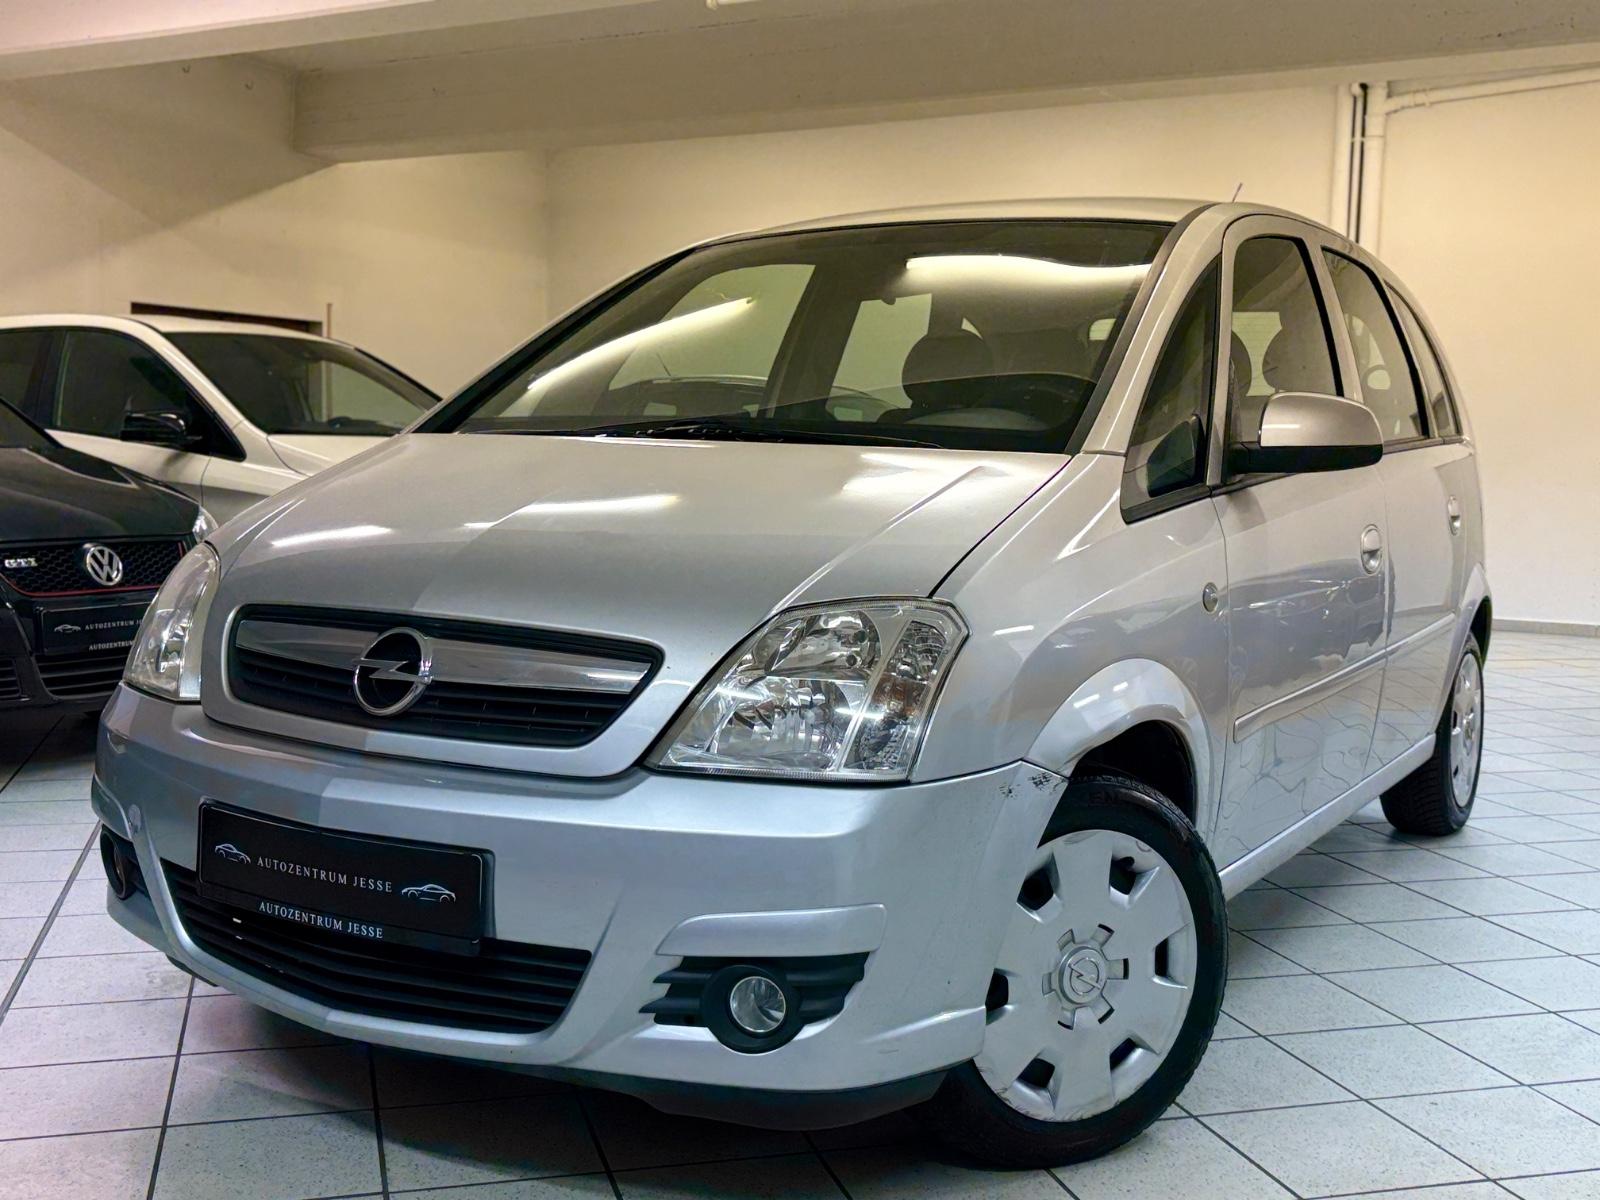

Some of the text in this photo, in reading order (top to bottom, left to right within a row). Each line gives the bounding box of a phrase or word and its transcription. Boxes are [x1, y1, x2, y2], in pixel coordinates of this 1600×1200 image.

[4, 557, 38, 568] GTI
[85, 620, 134, 630] AUTOZENTRUM
[257, 857, 392, 892] AUTOZENTRUM JESSE
[259, 901, 383, 938] AUTOZENTRUM JESSE
